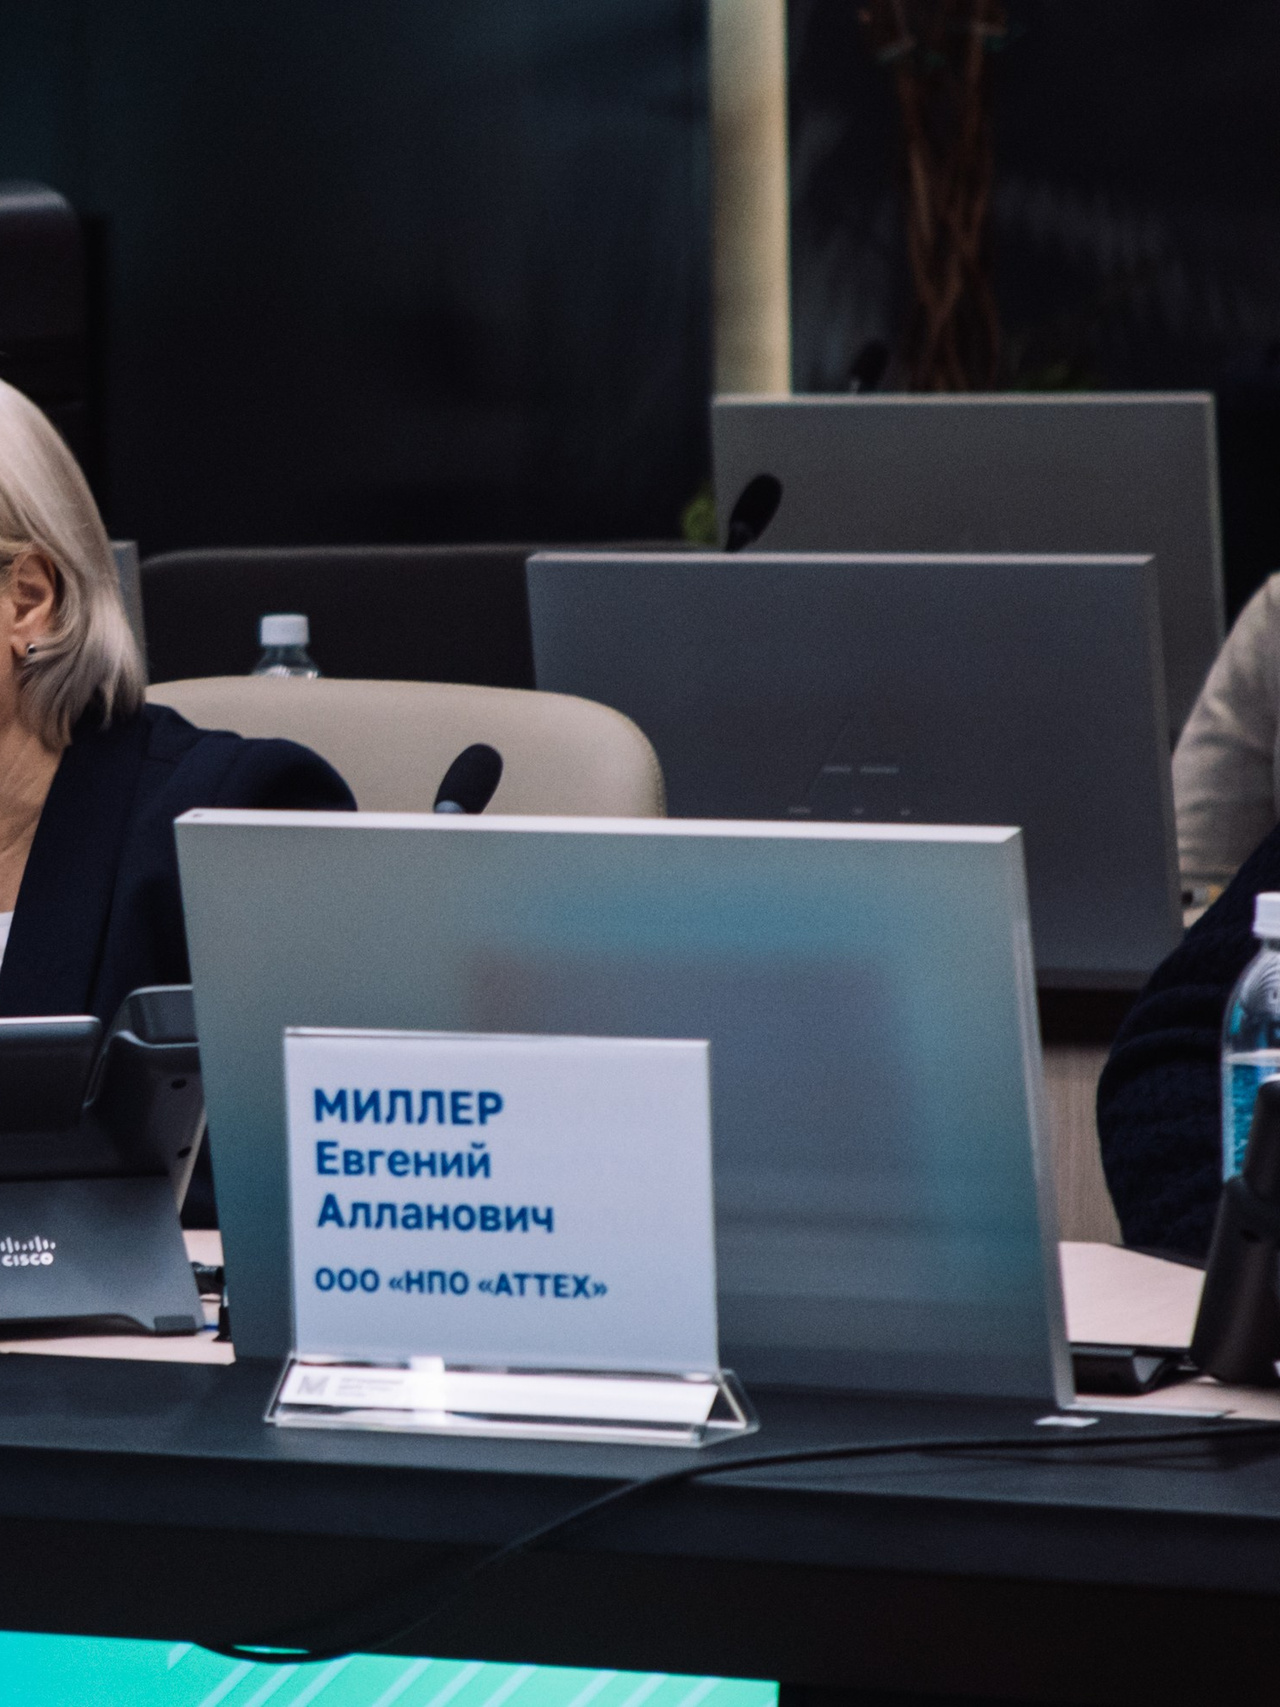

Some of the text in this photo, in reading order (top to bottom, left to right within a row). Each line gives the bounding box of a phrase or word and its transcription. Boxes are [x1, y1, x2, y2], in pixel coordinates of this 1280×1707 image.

[314, 1088, 504, 1125] МИЛЛЕР
[316, 1140, 491, 1178] Евгений
[317, 1193, 554, 1233] Алланович
[315, 1267, 608, 1299] ООО «НПО «АТТЕХ»
